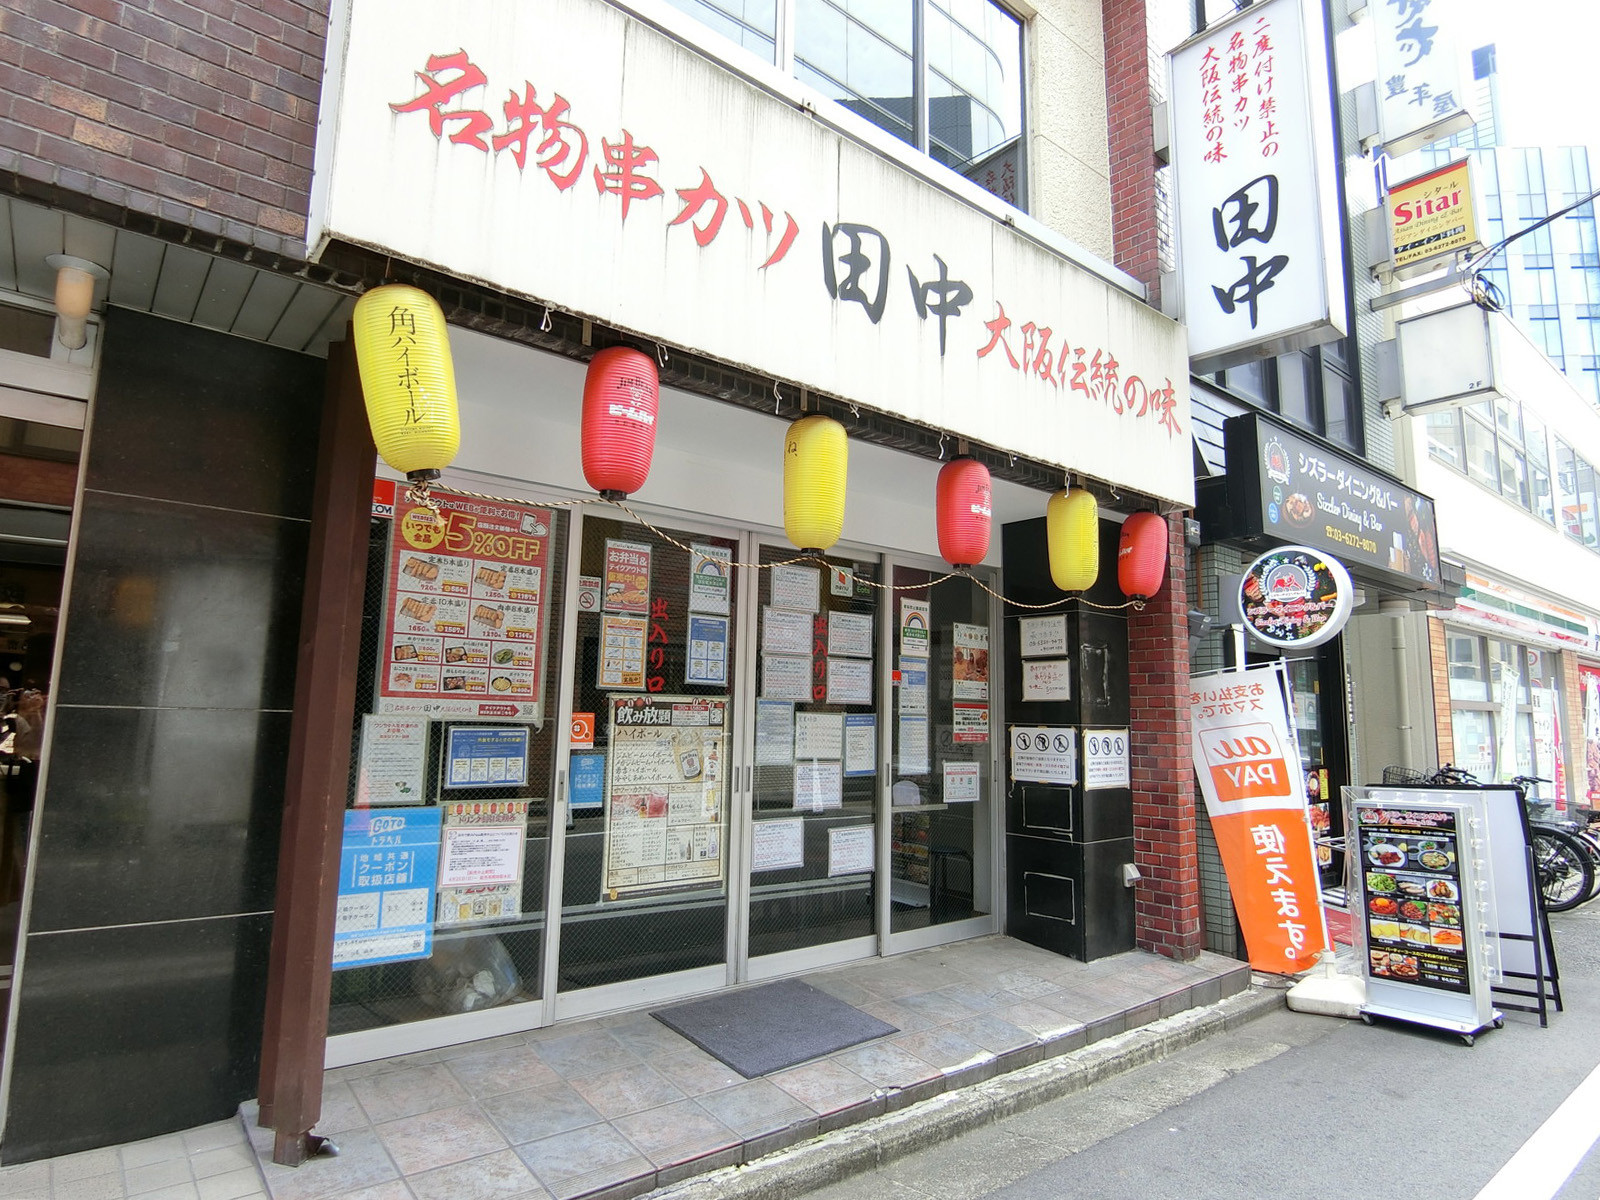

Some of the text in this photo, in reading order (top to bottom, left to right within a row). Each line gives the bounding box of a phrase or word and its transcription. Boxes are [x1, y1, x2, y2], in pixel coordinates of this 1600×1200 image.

[1199, 46, 1228, 164] 大阪伝統の味
[1226, 31, 1250, 132] 名物串カツ
[1252, 17, 1279, 157] 二度付け禁止の
[1393, 189, 1462, 226] Sitar
[1424, 181, 1459, 199] シタール
[388, 47, 1182, 439] 名物串カツ 田中 大阪伝統の味
[1211, 174, 1289, 329] 田中
[387, 306, 426, 427] 角ハイボール
[1298, 452, 1399, 512] シズラーダイニング&バー
[444, 511, 540, 561] 5%OFF
[1341, 502, 1363, 533] Dining
[1370, 513, 1383, 532] Bar
[609, 551, 648, 567] お弁当&
[647, 597, 669, 693] 出入り口
[616, 706, 671, 724] 飲み放題
[616, 728, 663, 740] ハイボール
[357, 872, 408, 887] 取扱店舗
[359, 861, 409, 875] クーポン
